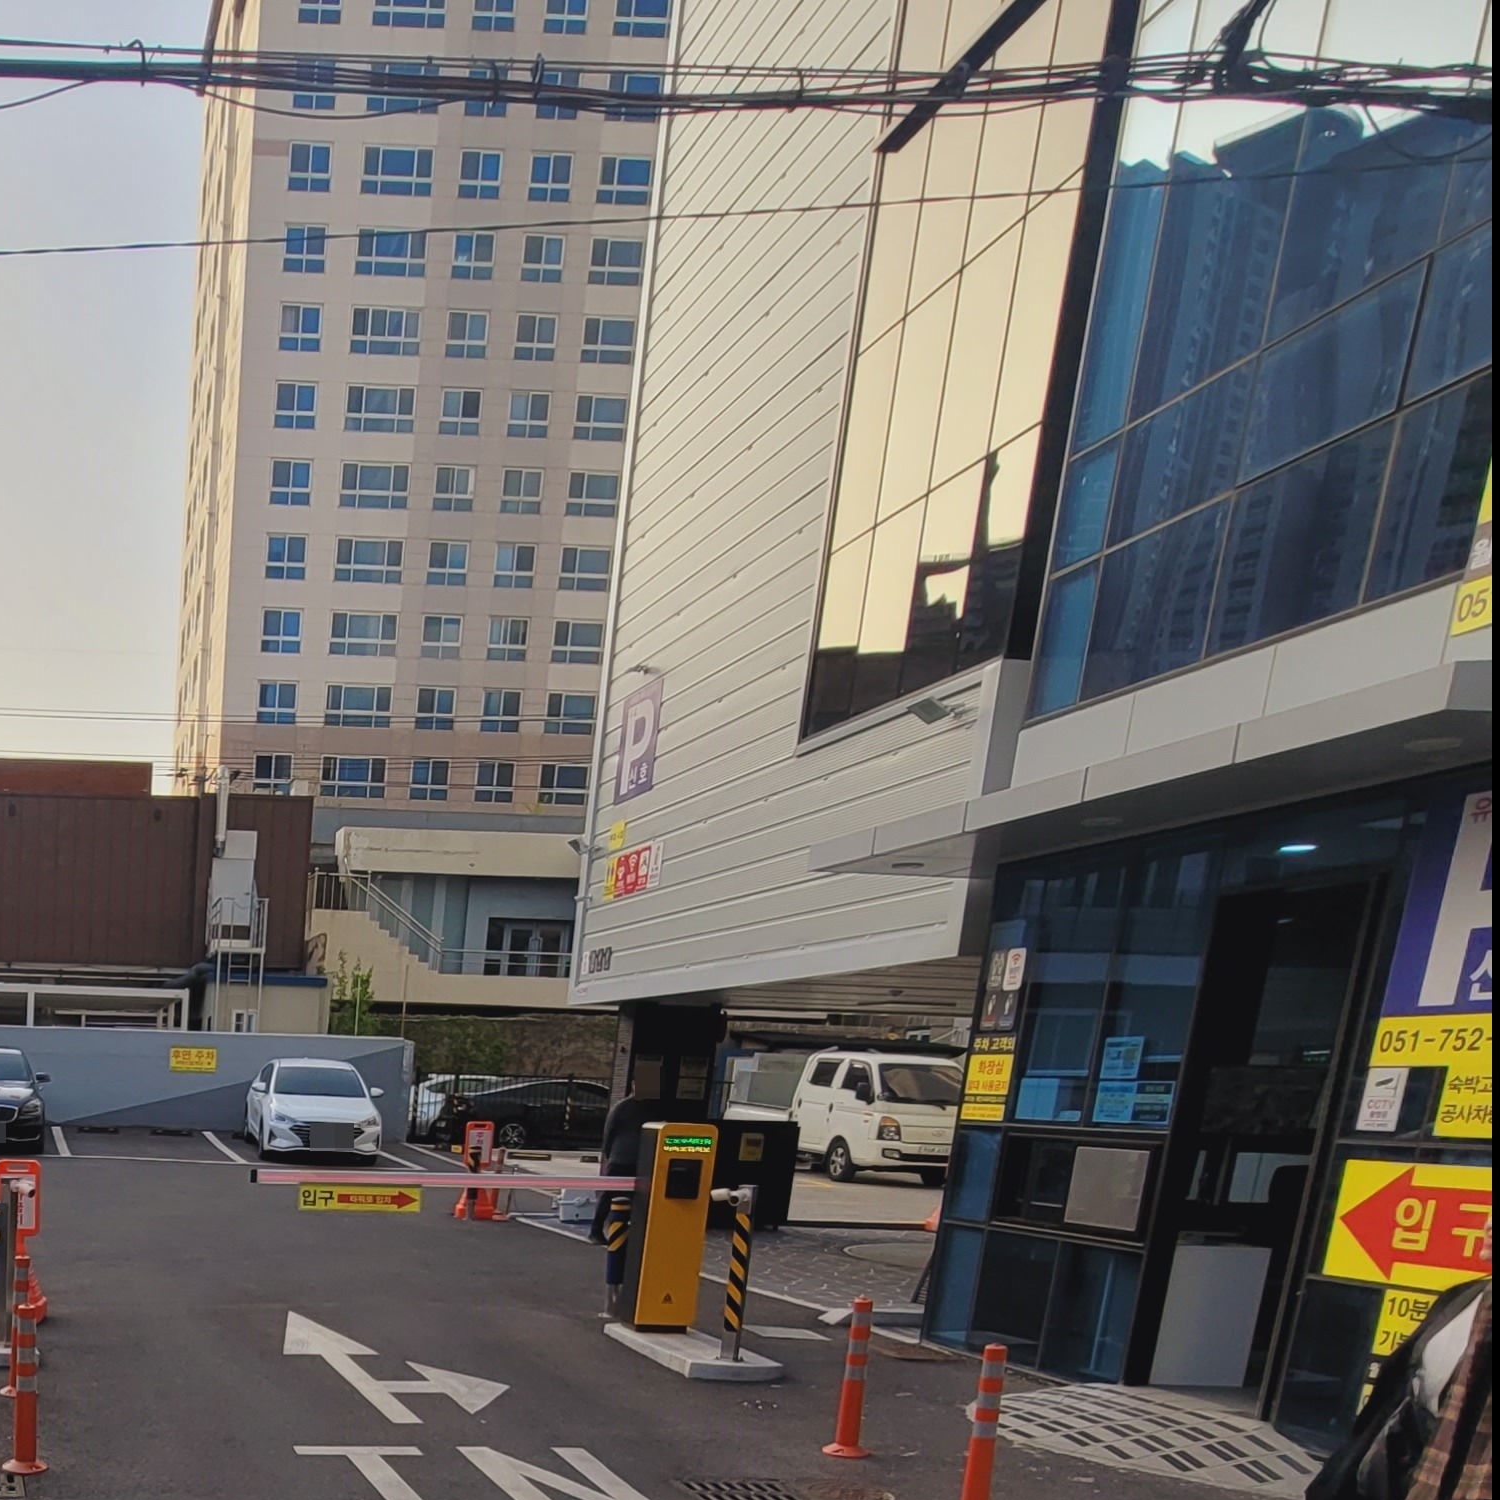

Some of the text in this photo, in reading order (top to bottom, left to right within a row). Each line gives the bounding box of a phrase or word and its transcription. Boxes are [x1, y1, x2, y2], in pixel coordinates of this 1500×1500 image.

[1457, 584, 1491, 623] 05
[619, 699, 654, 796] P
[194, 1050, 215, 1062] 주차
[977, 1060, 1005, 1075] 화장실
[1367, 1099, 1396, 1110] CCTV
[1439, 1103, 1491, 1125] 공사차
[301, 1189, 335, 1207] 입구
[1391, 1197, 1491, 1258] 입구
